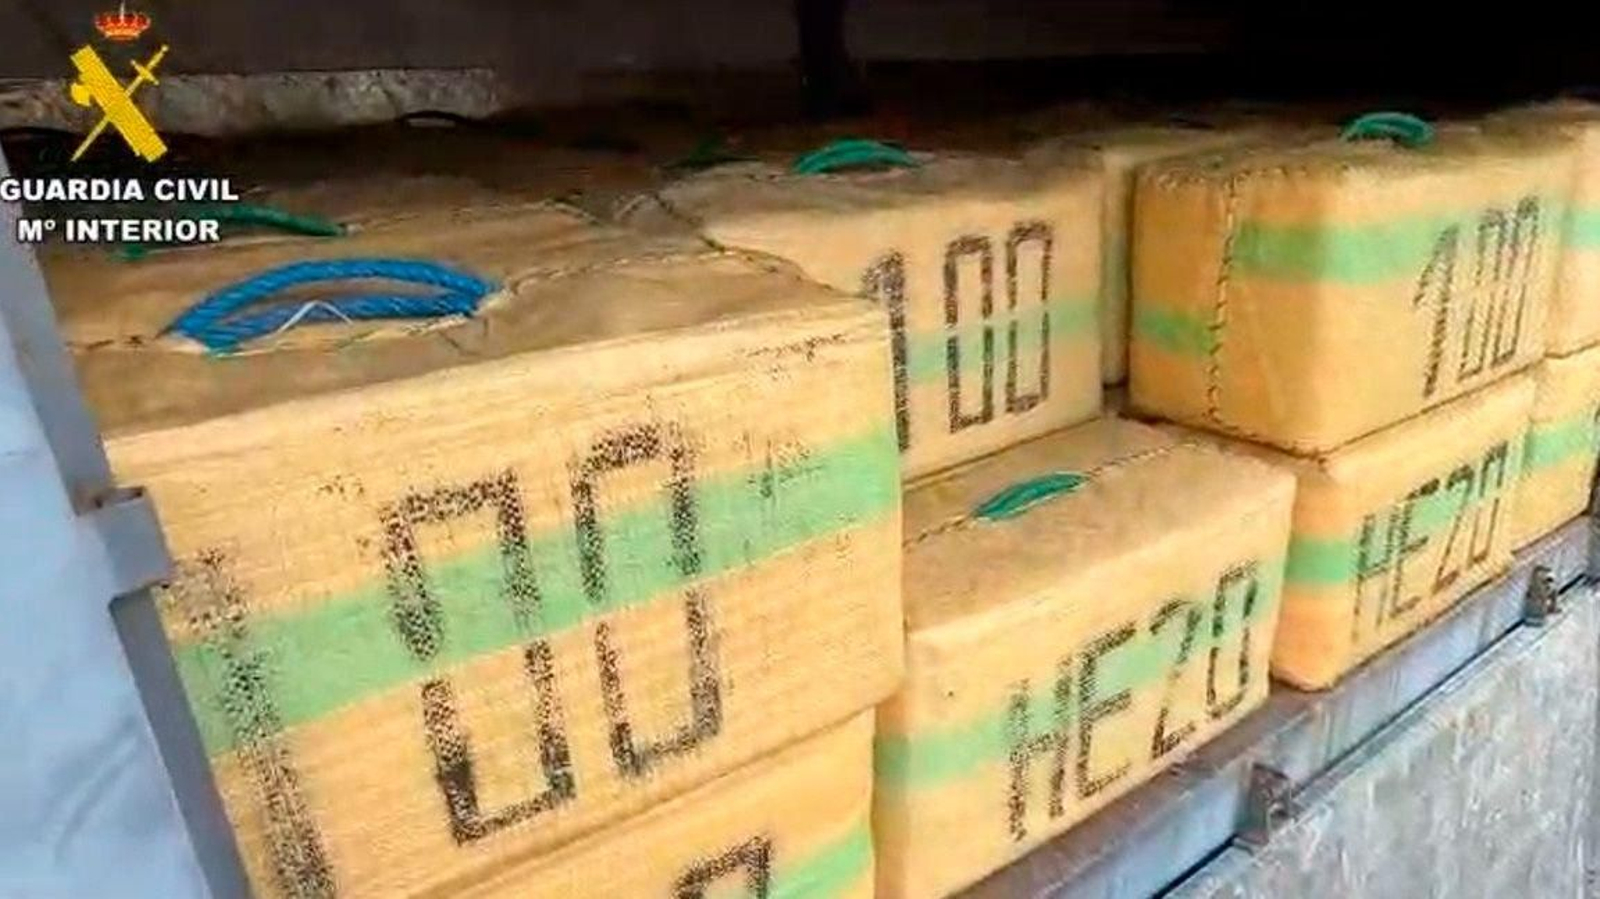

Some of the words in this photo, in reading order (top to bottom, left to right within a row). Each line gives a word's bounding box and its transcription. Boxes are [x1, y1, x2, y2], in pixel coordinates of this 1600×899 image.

[861, 218, 1054, 452] 100
[1412, 194, 1541, 398] 100
[1353, 438, 1509, 643] HE20
[1007, 559, 1258, 843] HE20
